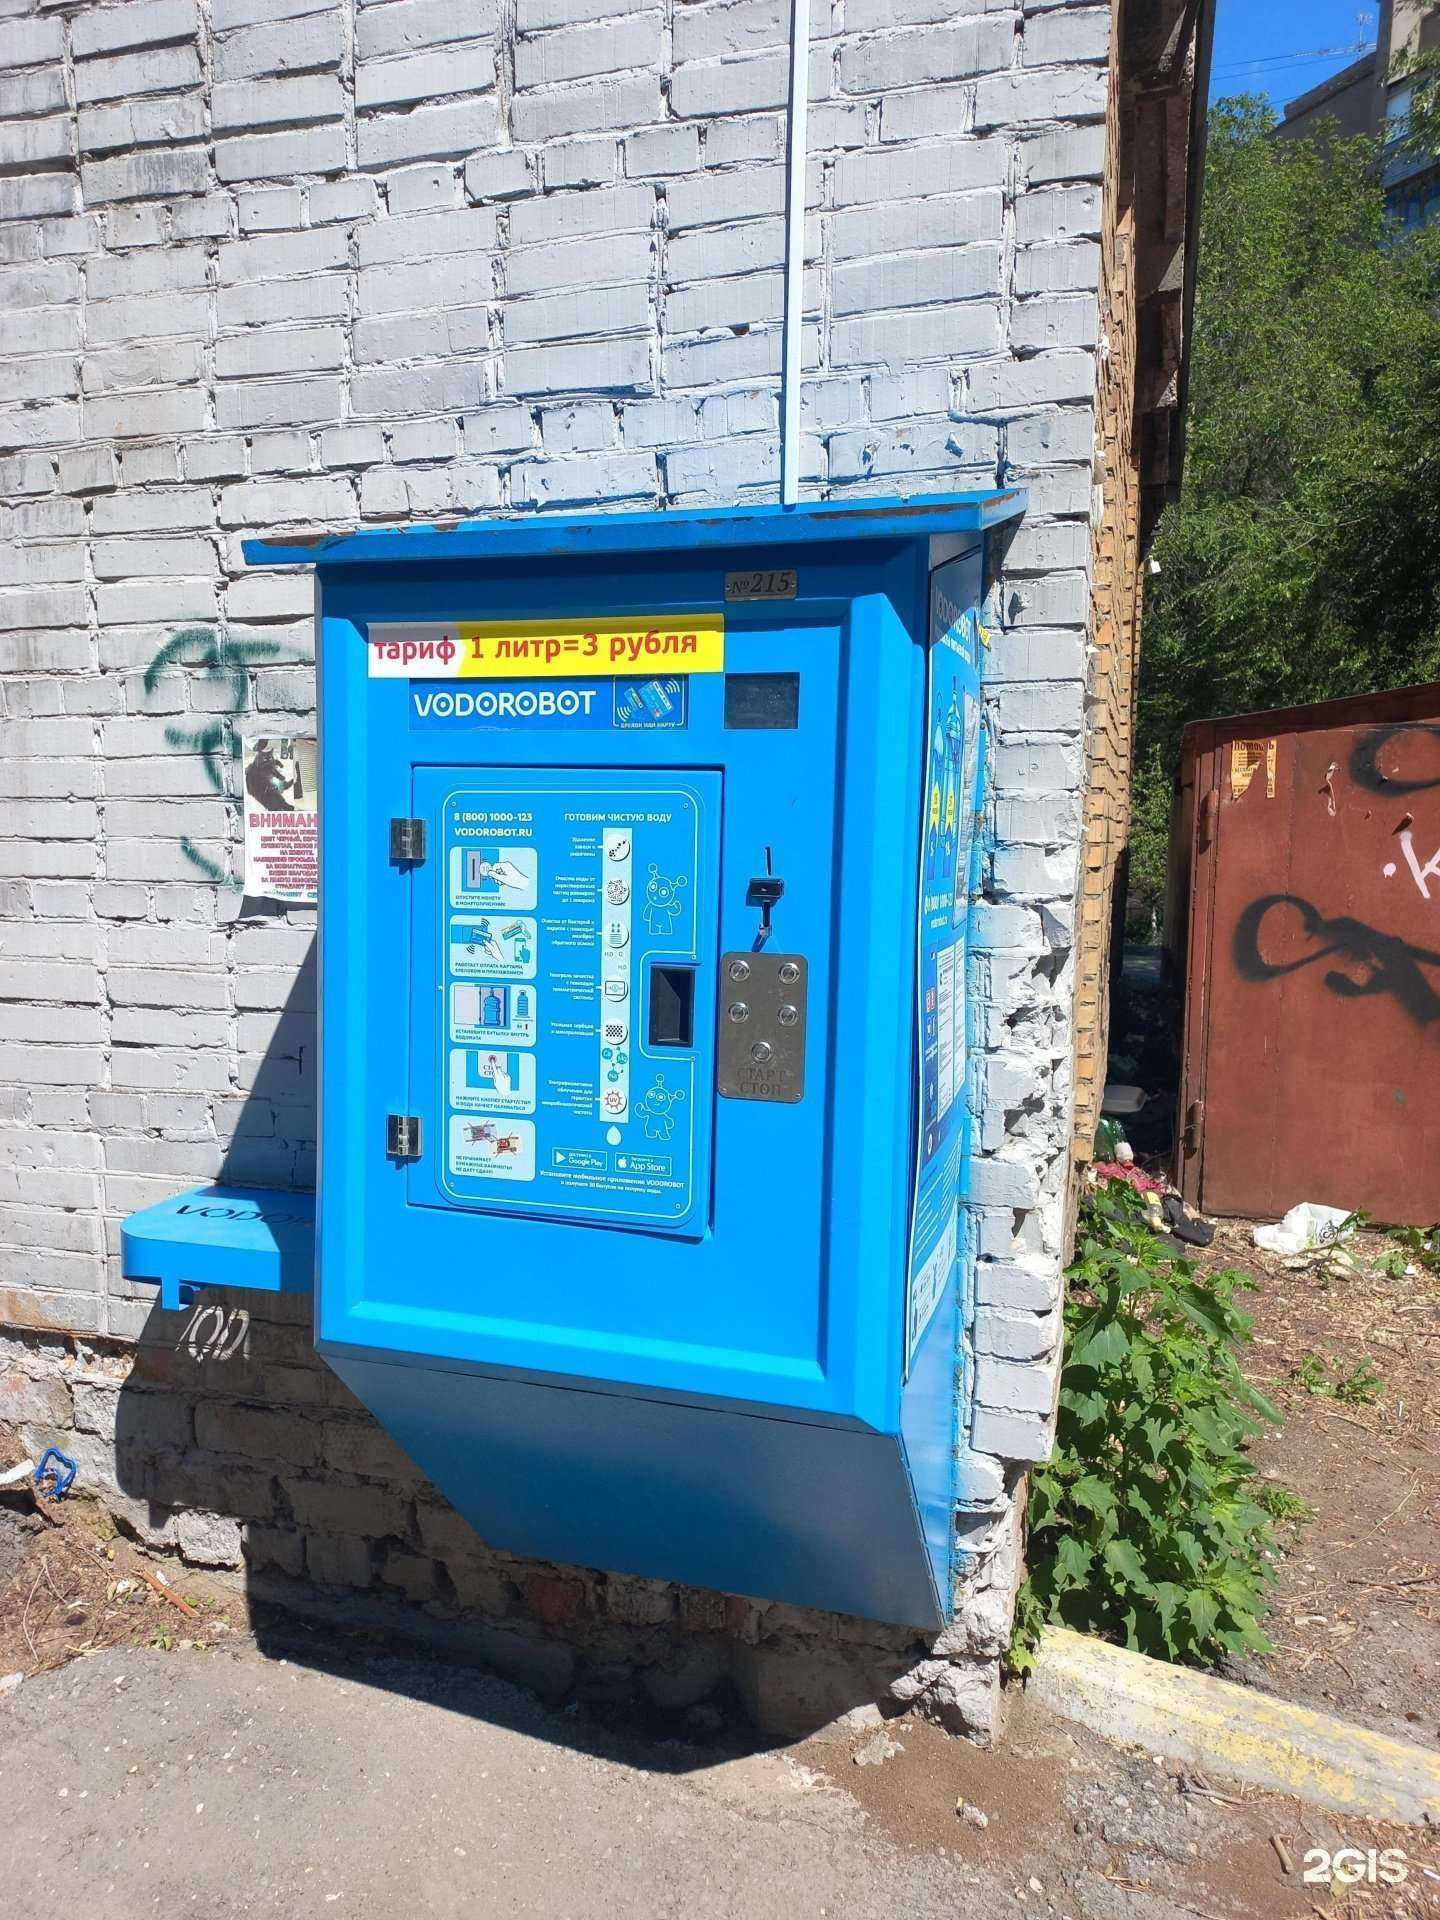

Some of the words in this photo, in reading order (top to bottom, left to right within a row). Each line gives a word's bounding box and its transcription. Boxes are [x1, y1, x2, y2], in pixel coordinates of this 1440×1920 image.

[374, 635, 457, 665] тариф
[471, 636, 485, 659] 1
[495, 632, 599, 663] литр=3
[609, 630, 698, 662] рубля
[413, 690, 597, 718] VODOROBOT
[454, 812, 461, 822] 8
[462, 812, 488, 823] (800)
[489, 812, 533, 822] 1000-123
[564, 813, 606, 822] ГОТОВИМ
[607, 813, 645, 822] ЧИСТУЮ
[646, 813, 672, 824] ВОДУ
[454, 827, 533, 837] VODOROBOT.RU
[630, 1162, 646, 1172] App
[647, 1163, 667, 1173] Store
